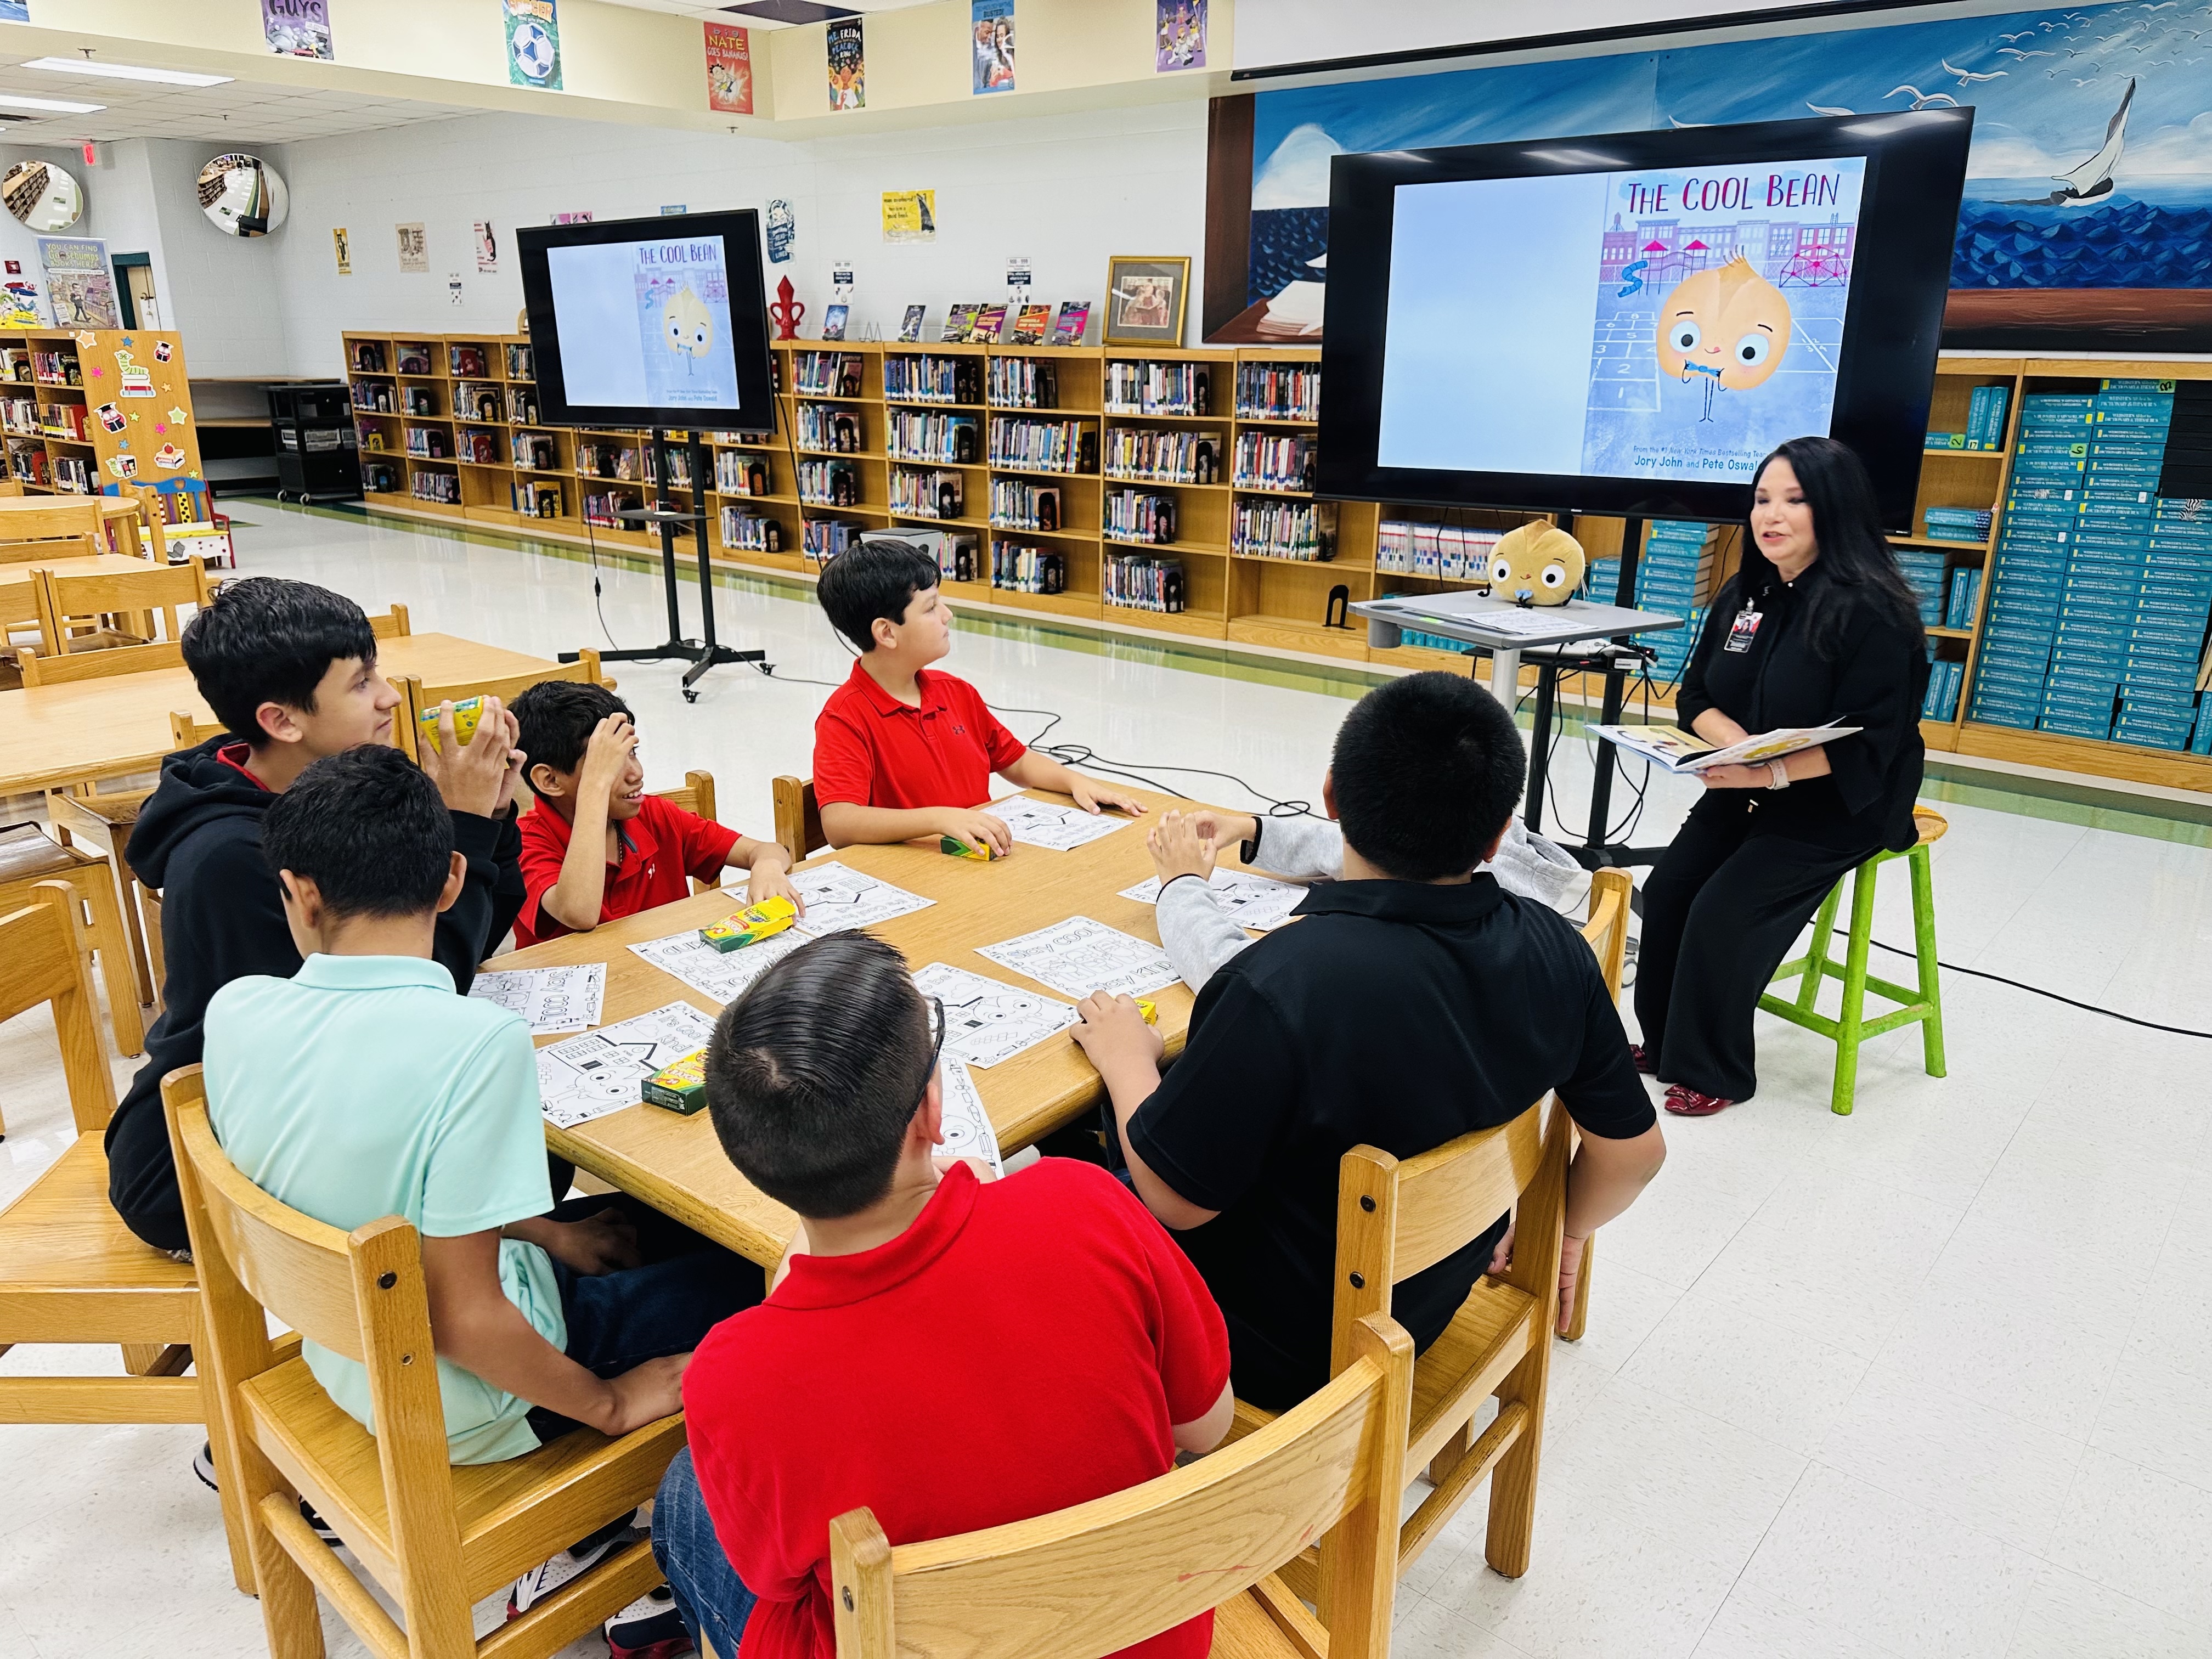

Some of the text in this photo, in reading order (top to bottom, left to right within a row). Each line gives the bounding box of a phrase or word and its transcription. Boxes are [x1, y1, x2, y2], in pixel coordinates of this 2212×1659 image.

[709, 35, 745, 50] NATE
[1628, 173, 1840, 214] THE COOL BEAN
[639, 244, 716, 264] THE COOL BEAN
[1595, 345, 1606, 353] 3
[1618, 364, 1630, 374] 2
[1718, 449, 1751, 458] Bestselling
[1635, 455, 1757, 471] Jory John and Pete Oswal
[1007, 927, 1105, 959] Stay COOL
[540, 970, 573, 992] Stay
[927, 975, 952, 985] be
[540, 995, 569, 1021] COOL
[676, 1025, 708, 1040] Cool
[656, 1034, 694, 1053] Kind!
[664, 1069, 703, 1084] CRAYONS
